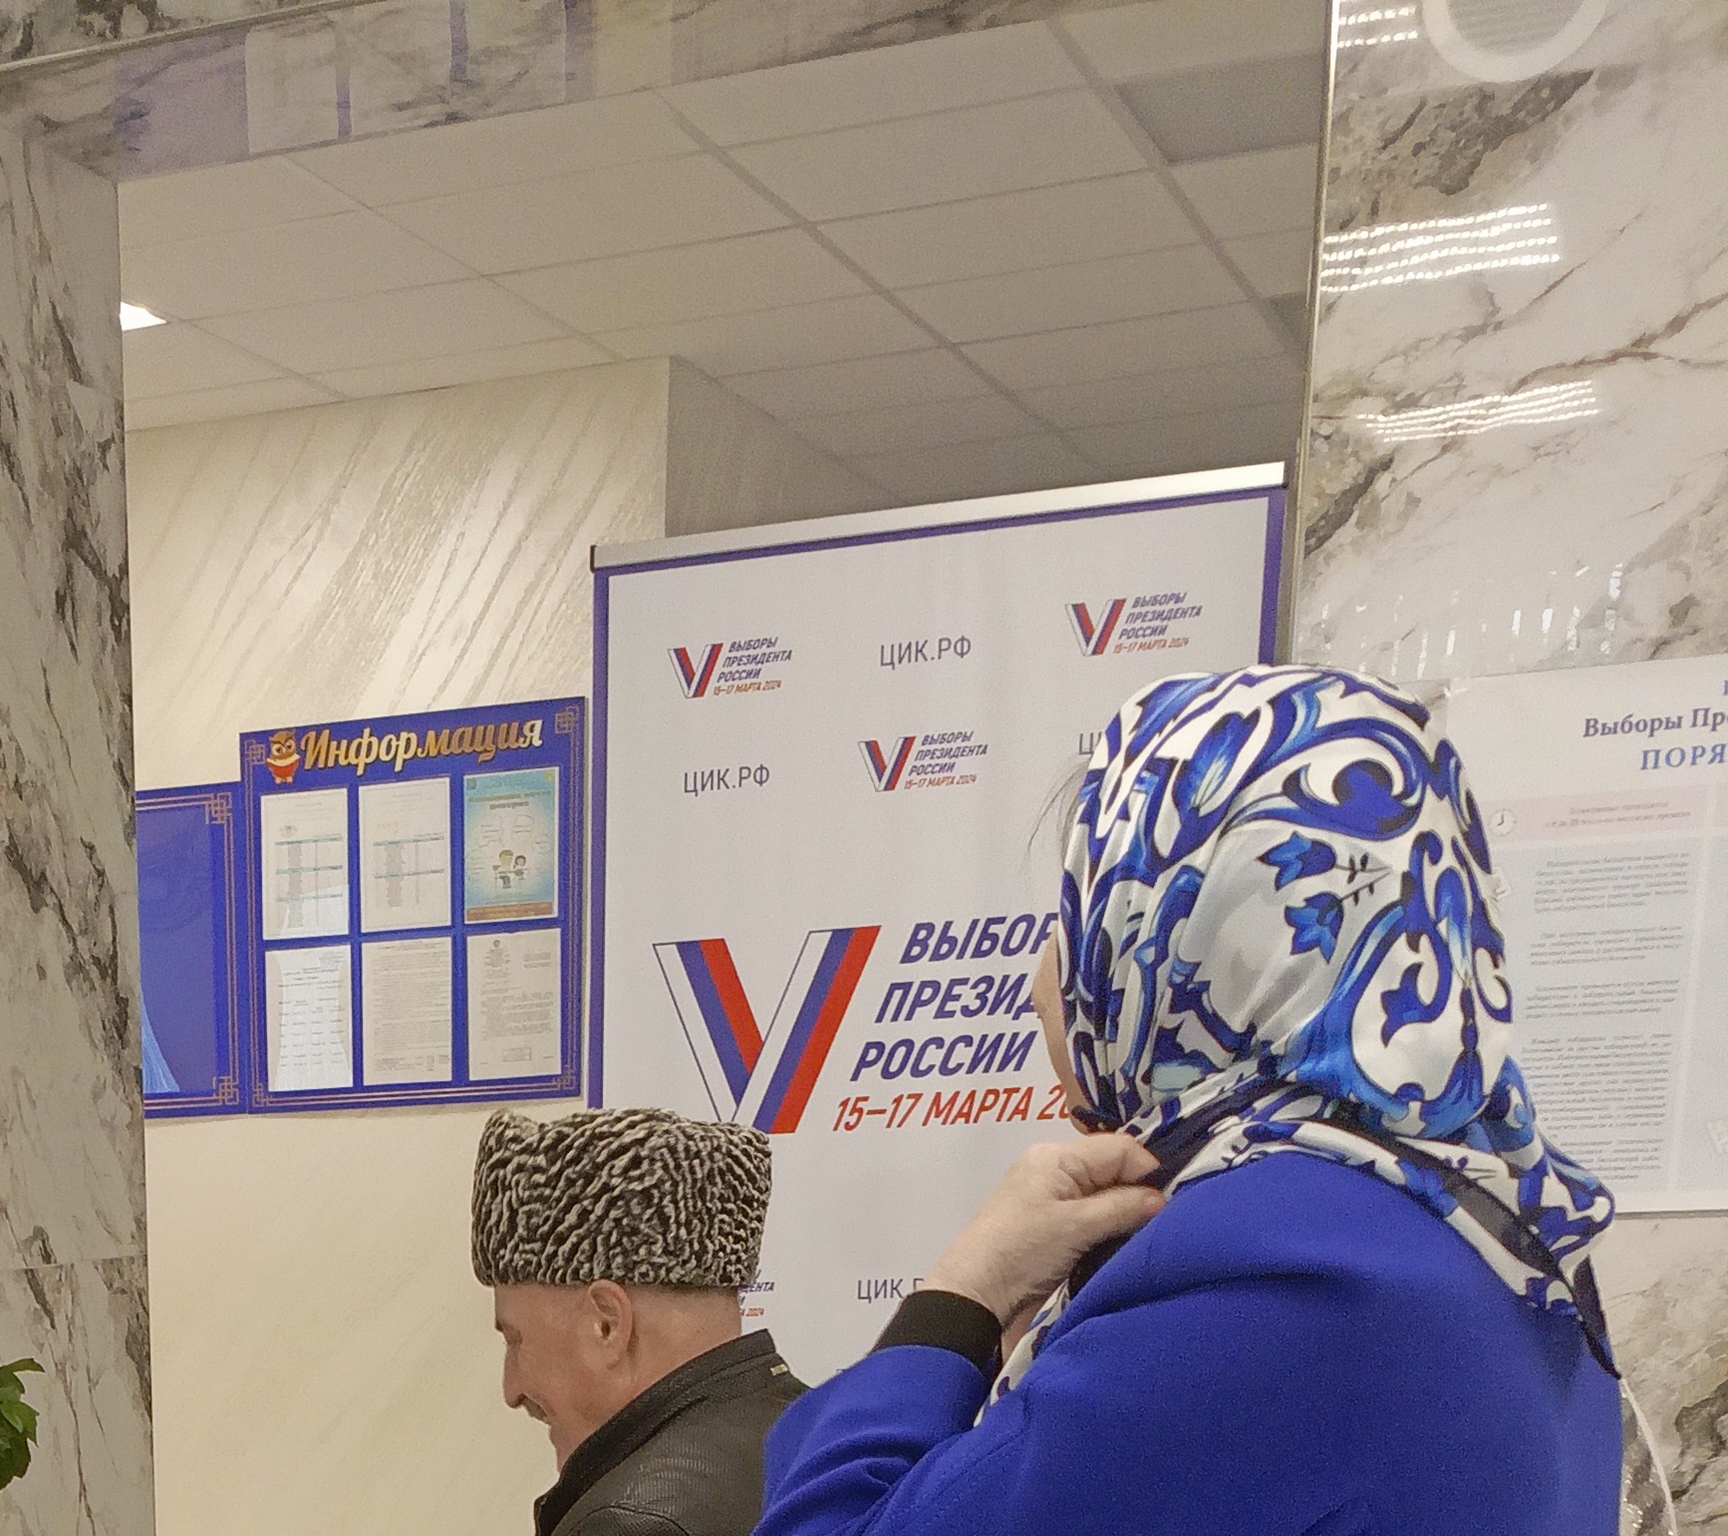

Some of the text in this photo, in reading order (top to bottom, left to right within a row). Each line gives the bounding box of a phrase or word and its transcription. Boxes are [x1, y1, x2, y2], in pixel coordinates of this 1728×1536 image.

[1132, 592, 1187, 608] ВЫБОРЫ
[1125, 605, 1203, 624] ПРЕЗИДЕНТА
[1118, 625, 1169, 639] РОССИИ
[728, 637, 779, 653] ВЫБОРЫ
[880, 635, 972, 670] ЦИК.РФ
[722, 650, 792, 668] ПРЕЗИДЕНТА
[717, 668, 762, 683] РОССИИ
[1582, 712, 1684, 738] Выборы
[299, 719, 544, 777] Информация
[921, 731, 974, 746] ВЫБОРЫ
[914, 744, 988, 761] ПРЕЗИДЕНТА
[1640, 743, 1727, 770] ПОРЯ
[908, 762, 956, 776] РОССИИ
[684, 764, 770, 797] ЦИК.РФ
[900, 912, 1059, 964] ВЫБОР
[850, 1030, 1038, 1081] РОССИИ
[922, 1086, 1034, 1127] МАРТА
